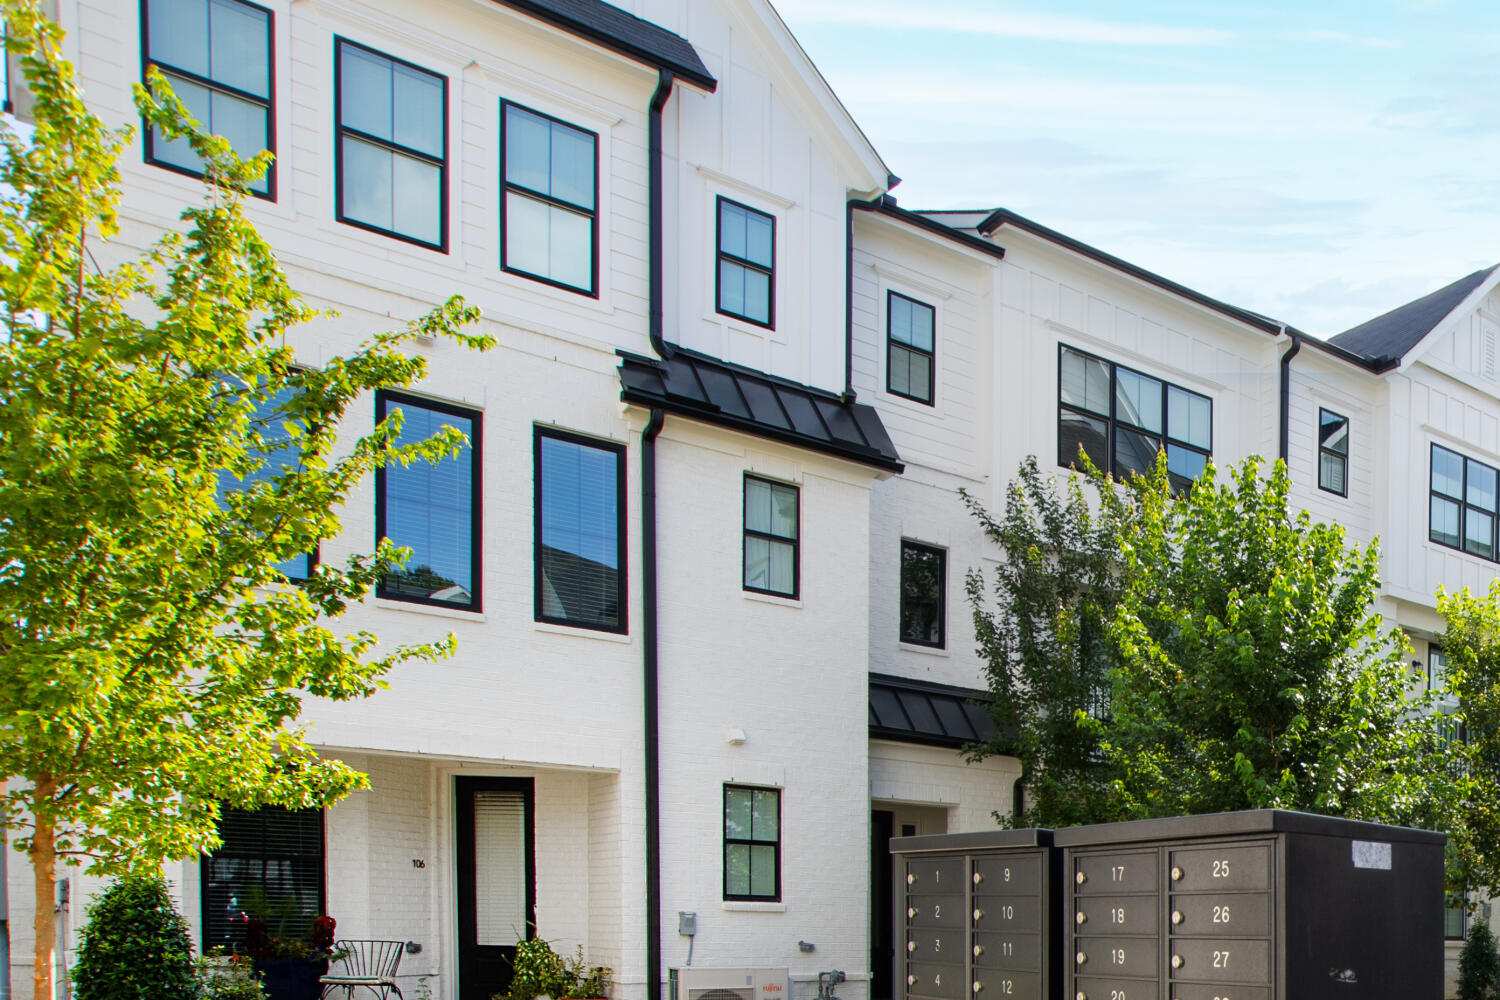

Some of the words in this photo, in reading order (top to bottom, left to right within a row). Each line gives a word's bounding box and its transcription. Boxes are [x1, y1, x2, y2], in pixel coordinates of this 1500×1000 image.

[412, 859, 426, 869] 106
[1212, 860, 1230, 878] 25
[1111, 866, 1125, 881] 17
[1002, 905, 1014, 920] 10
[1111, 907, 1125, 924] 18
[1212, 905, 1230, 923] 26
[1002, 942, 1012, 957] 11
[1111, 948, 1125, 965] 19
[1213, 950, 1230, 968] 27
[1001, 979, 1013, 995] 12
